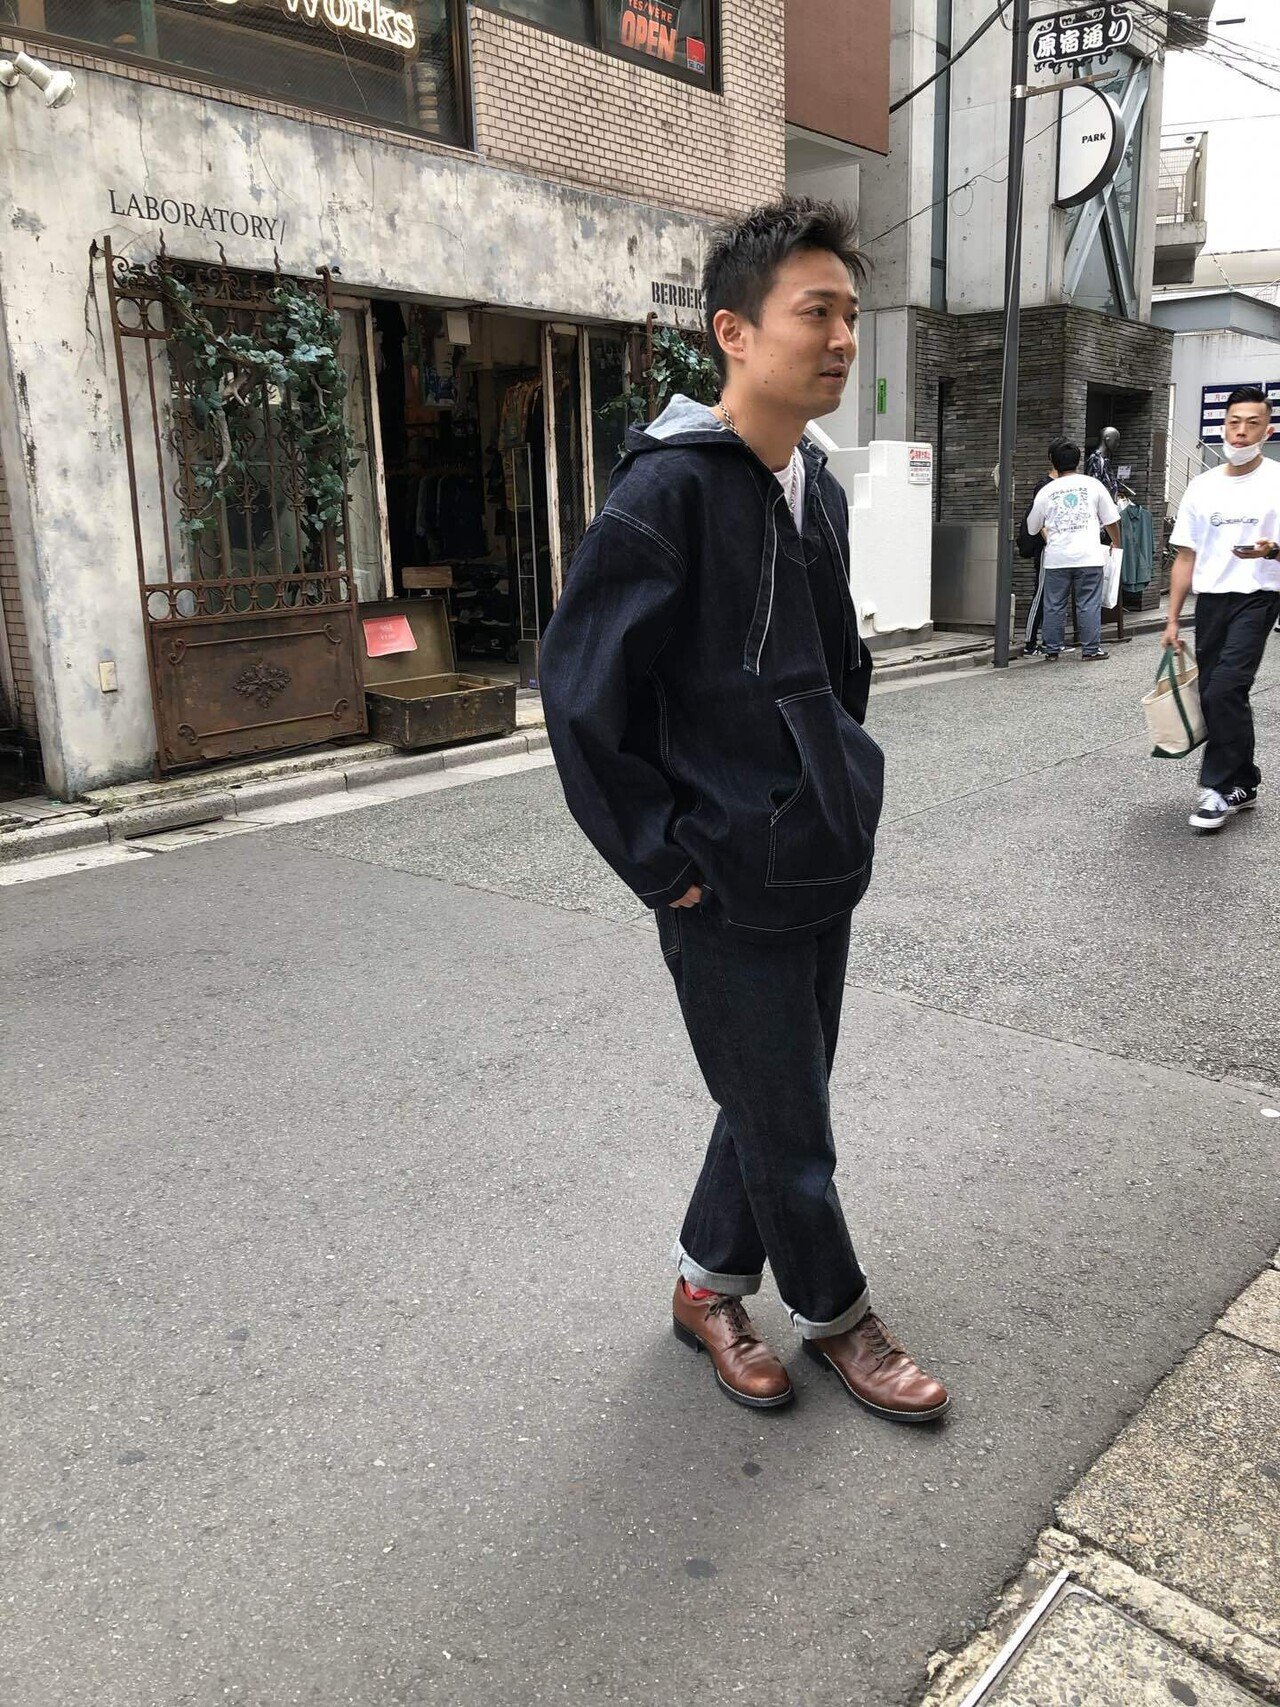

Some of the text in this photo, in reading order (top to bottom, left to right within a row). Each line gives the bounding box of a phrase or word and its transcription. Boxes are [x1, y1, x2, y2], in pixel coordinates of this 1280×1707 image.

[621, 10, 677, 62] OPEN
[1036, 19, 1128, 58] 原宿通り
[1081, 132, 1107, 144] PARK
[651, 281, 707, 311] BERBER
